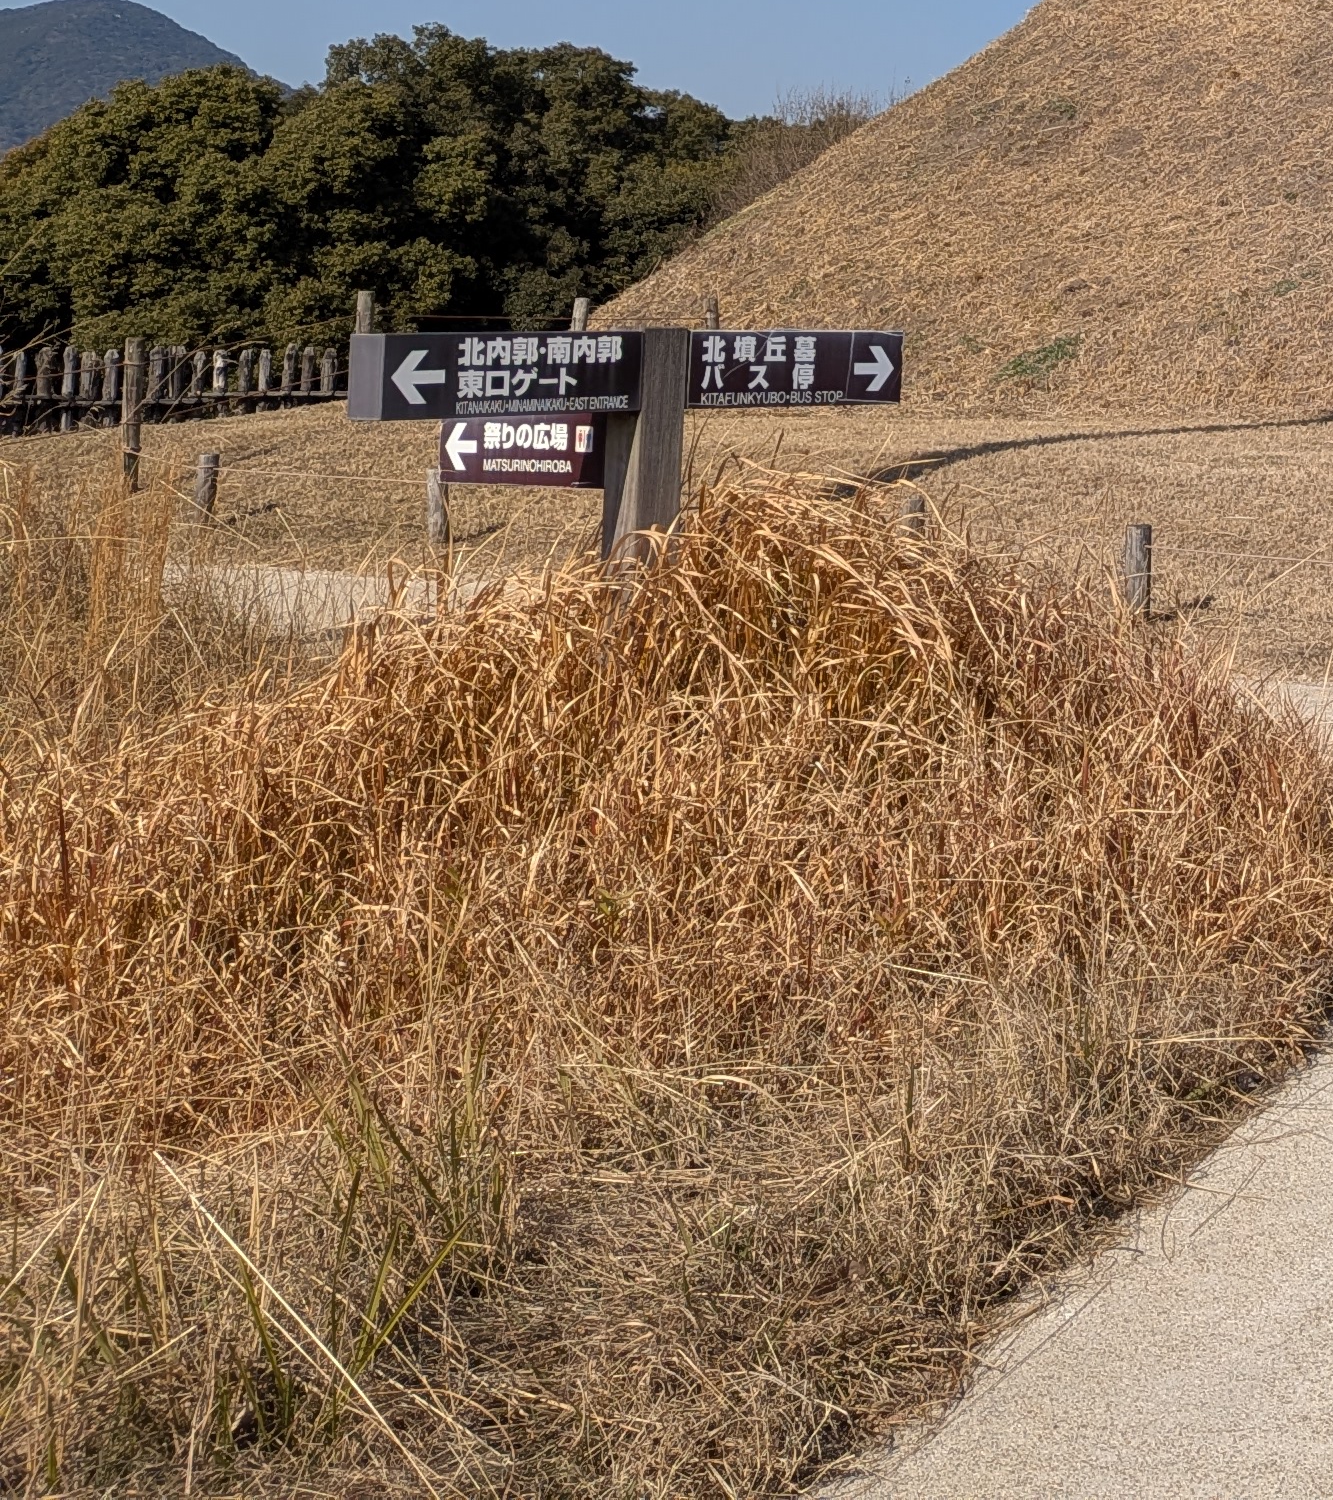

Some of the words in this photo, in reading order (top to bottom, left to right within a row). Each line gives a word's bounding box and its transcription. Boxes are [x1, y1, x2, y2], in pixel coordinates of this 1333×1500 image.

[458, 335, 623, 366] 北内郭・南内郭
[457, 367, 578, 398] 東口ゲート
[590, 395, 629, 410] ENTRANCE
[814, 390, 843, 404] STOP
[483, 421, 569, 451] 祭りの広場
[483, 459, 573, 473] MATSURINOHIROBA
